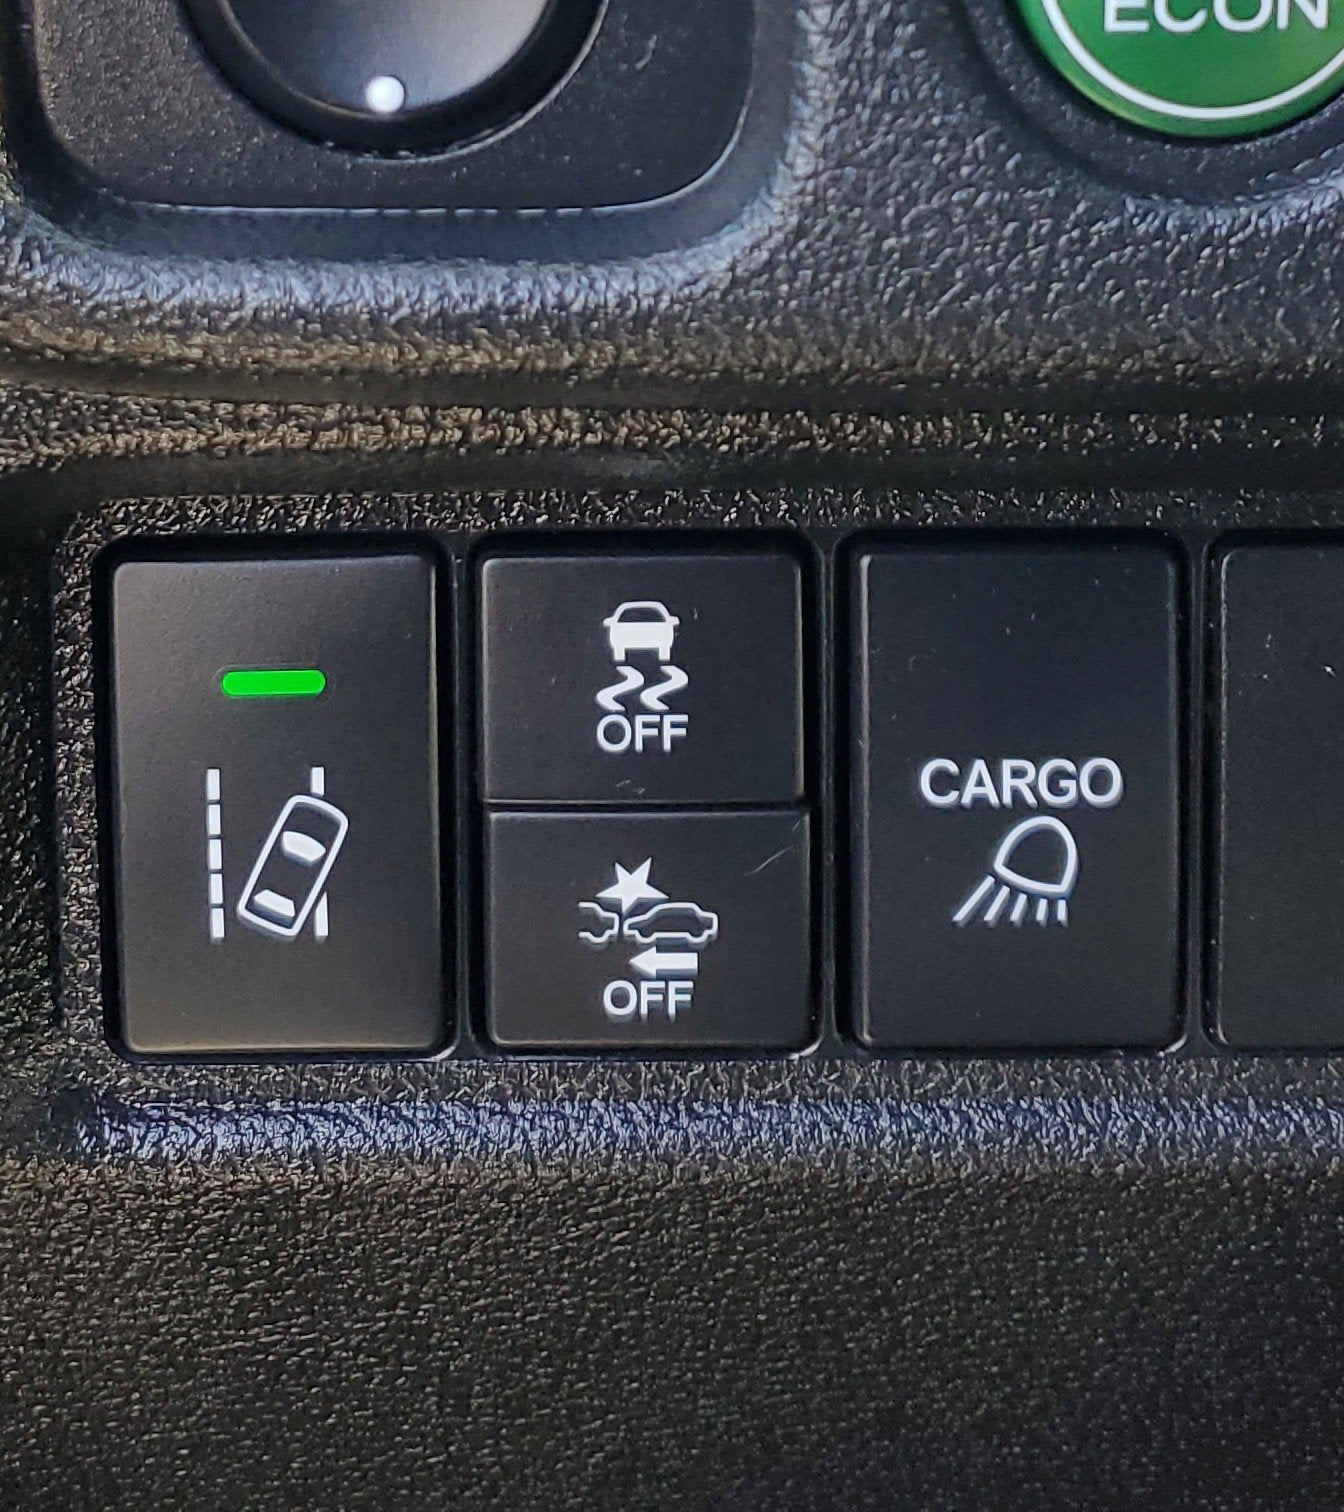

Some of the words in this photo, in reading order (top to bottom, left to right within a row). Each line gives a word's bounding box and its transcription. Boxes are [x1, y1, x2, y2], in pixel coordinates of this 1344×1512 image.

[595, 713, 690, 754] OFF
[918, 757, 1124, 808] CARGO
[601, 978, 695, 1019] OFF
